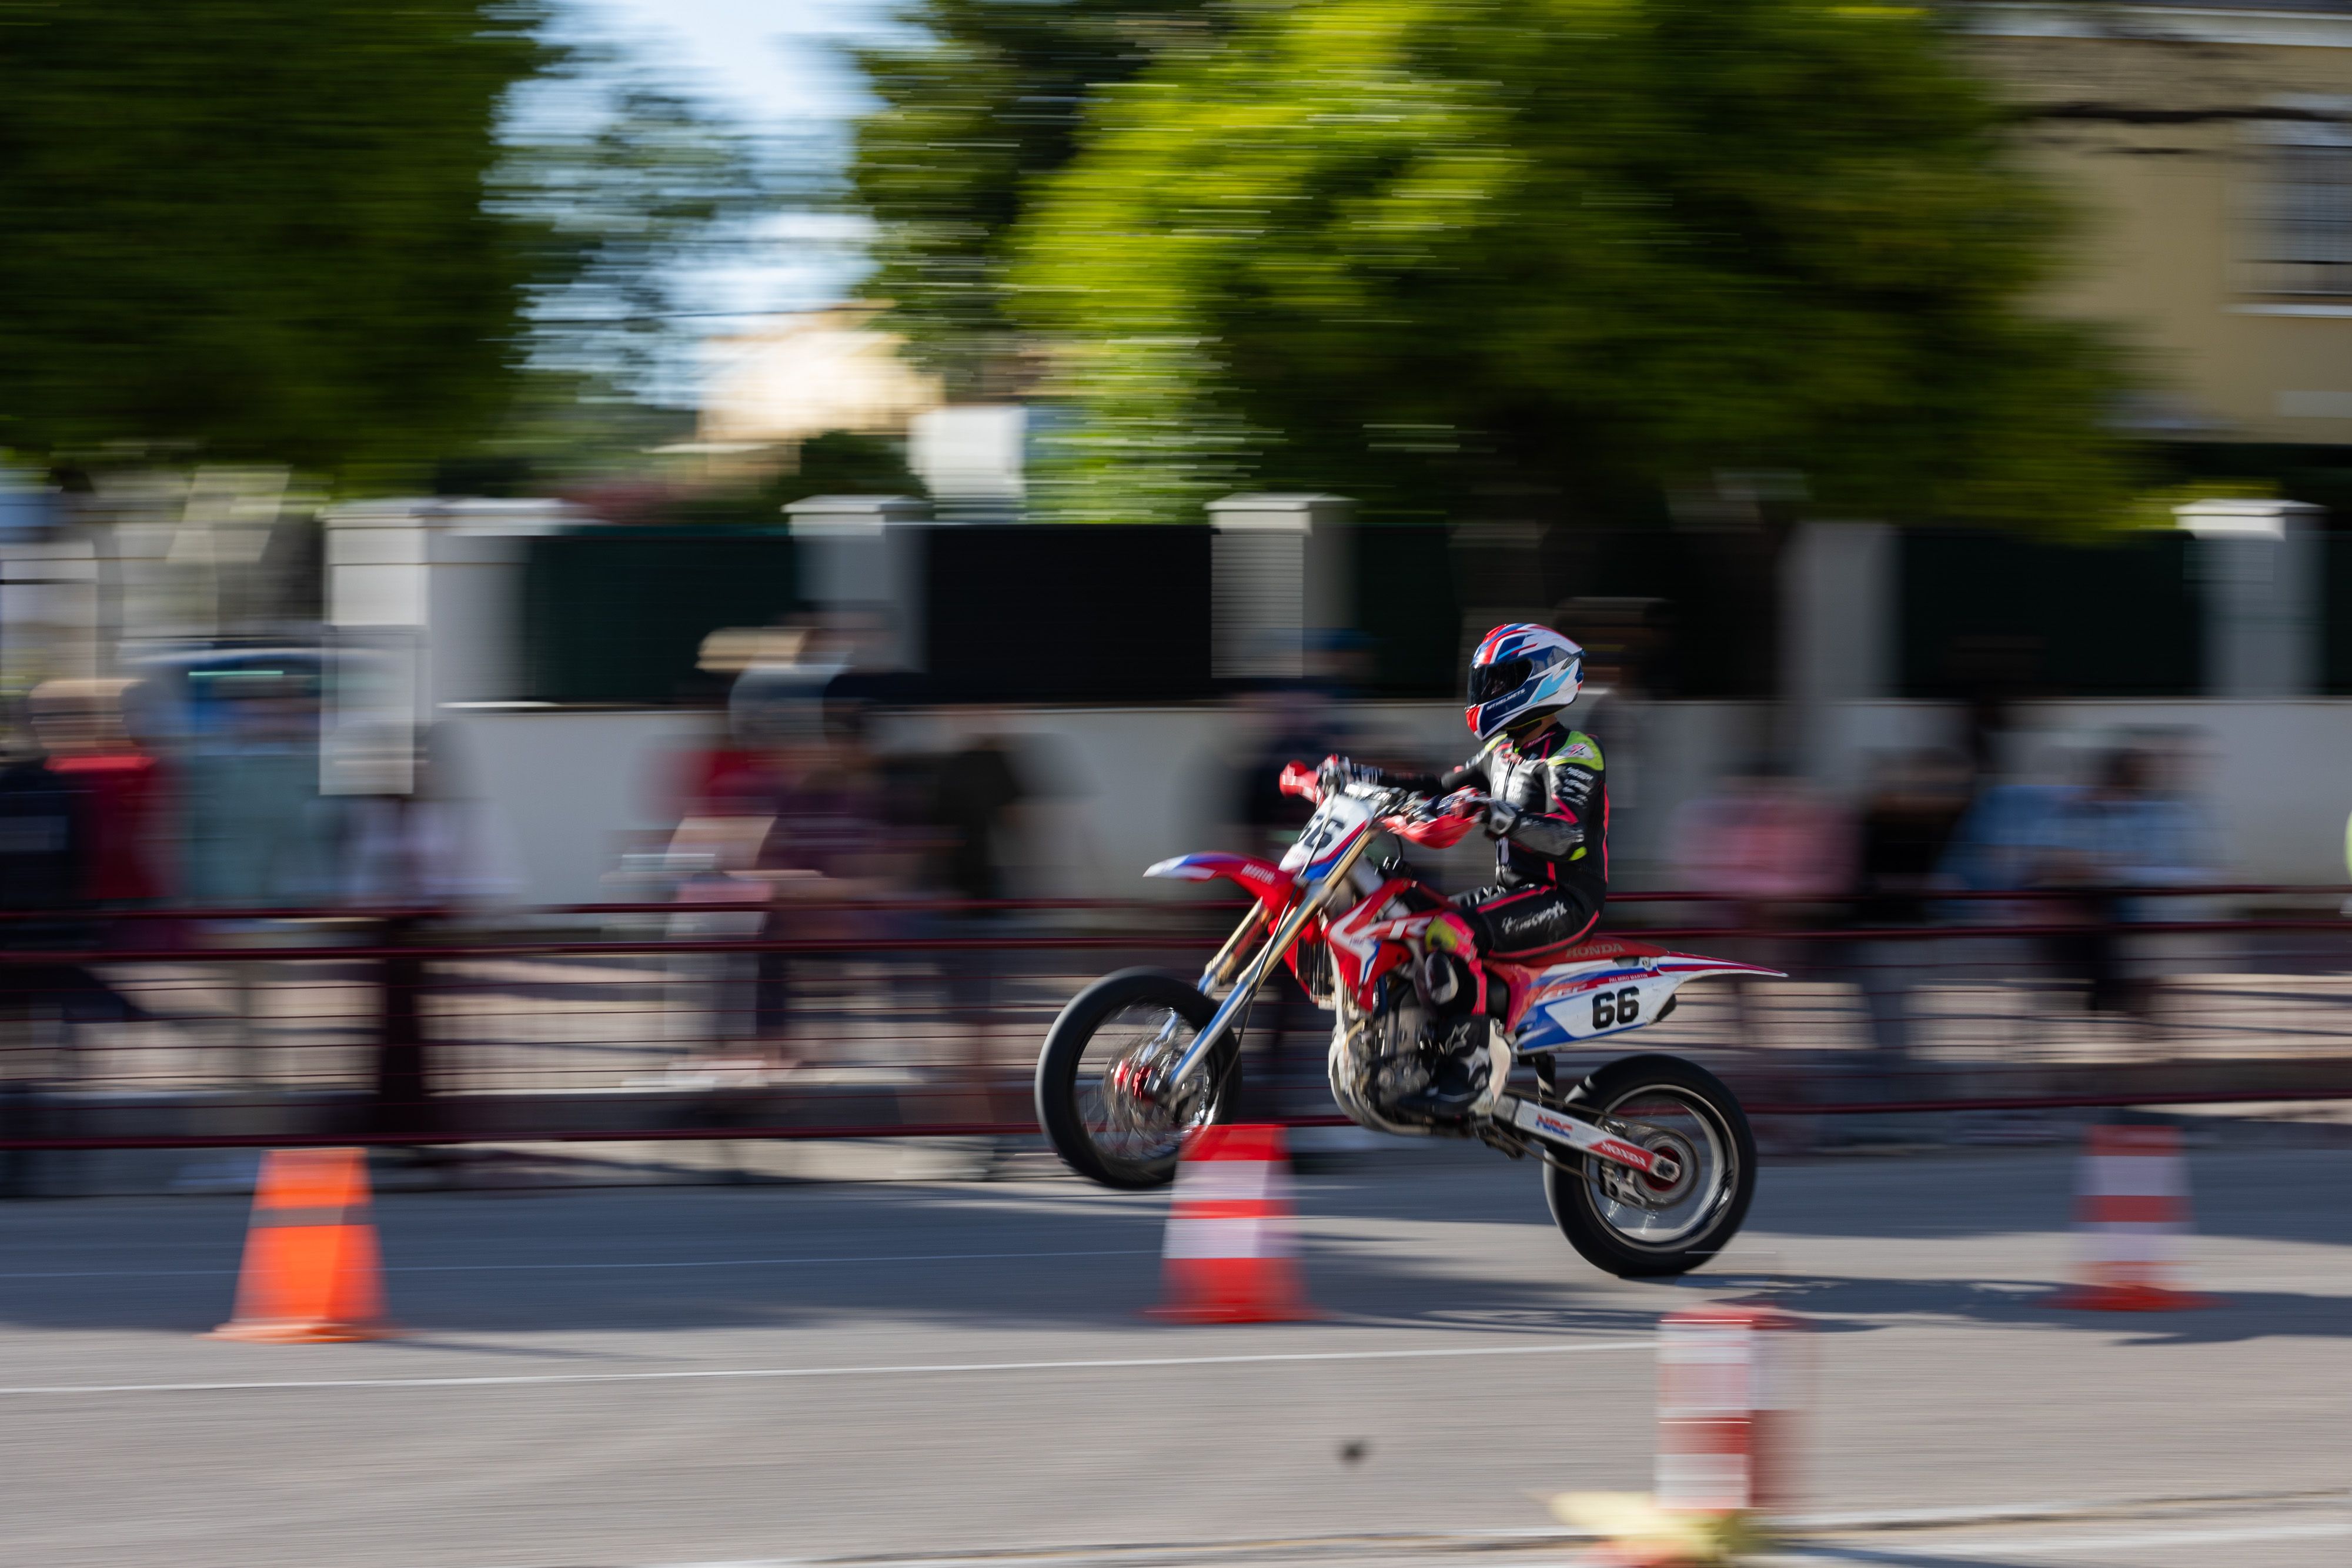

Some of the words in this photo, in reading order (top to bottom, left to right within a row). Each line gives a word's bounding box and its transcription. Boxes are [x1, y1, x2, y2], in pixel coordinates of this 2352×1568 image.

[1565, 942, 1626, 959] HONDA
[1608, 975, 1630, 984] PALMIRO
[1592, 986, 1640, 1030] 66
[1601, 1141, 1647, 1168] HONDA
